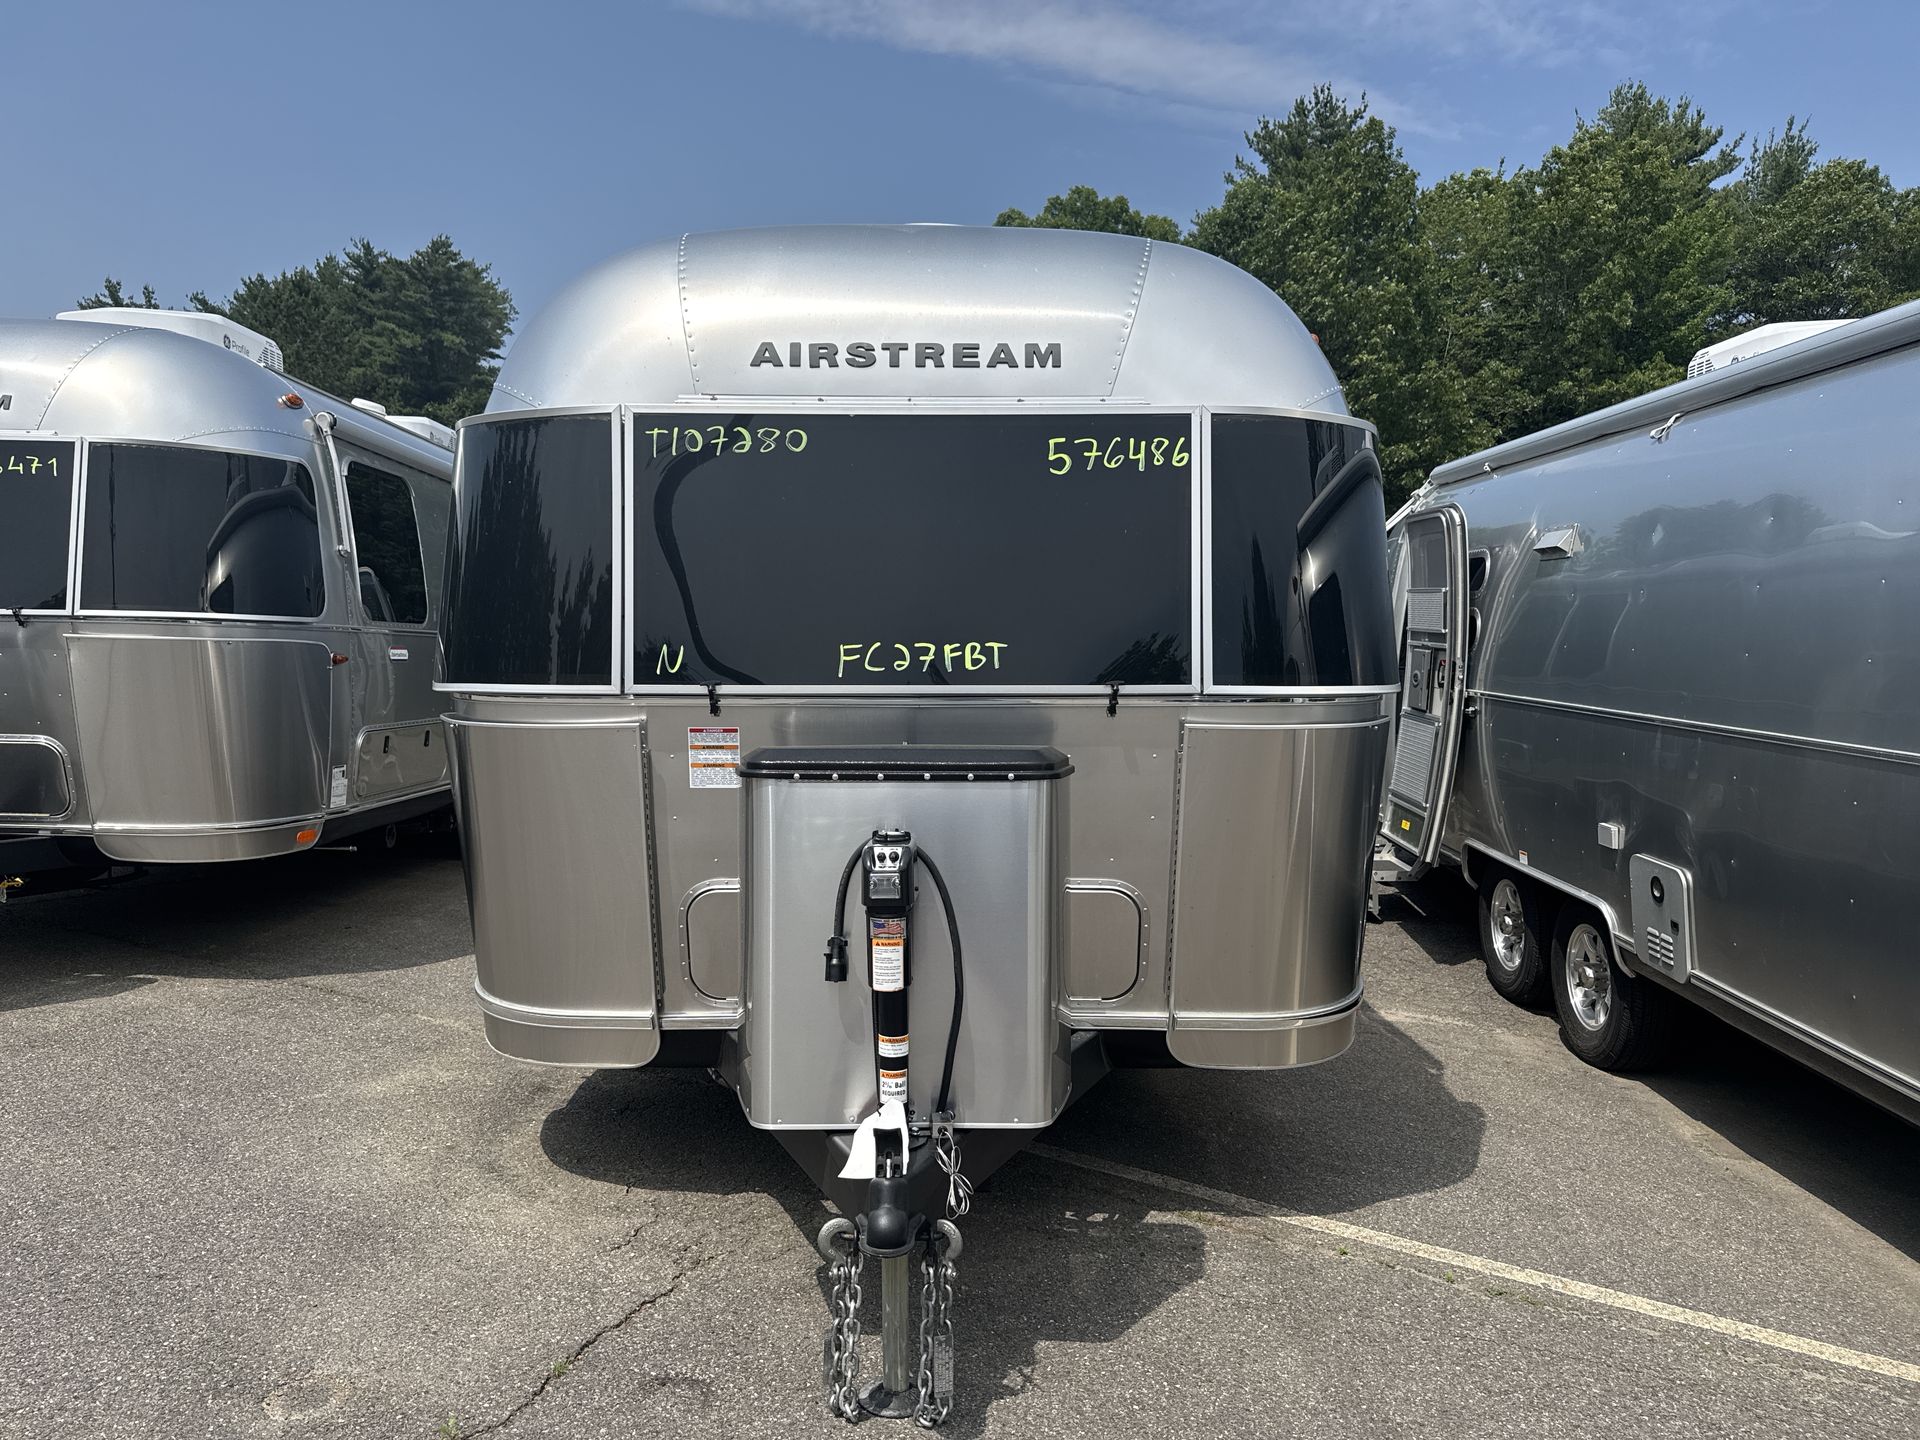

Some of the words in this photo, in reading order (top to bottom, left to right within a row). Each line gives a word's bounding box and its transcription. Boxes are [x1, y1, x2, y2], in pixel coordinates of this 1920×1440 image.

[750, 341, 1062, 369] AIRSTREAM
[644, 425, 808, 458] T107280
[1048, 437, 1190, 475] 576486
[656, 643, 684, 675] N
[838, 642, 1008, 678] FC27FBT
[894, 1080, 906, 1089] Ball
